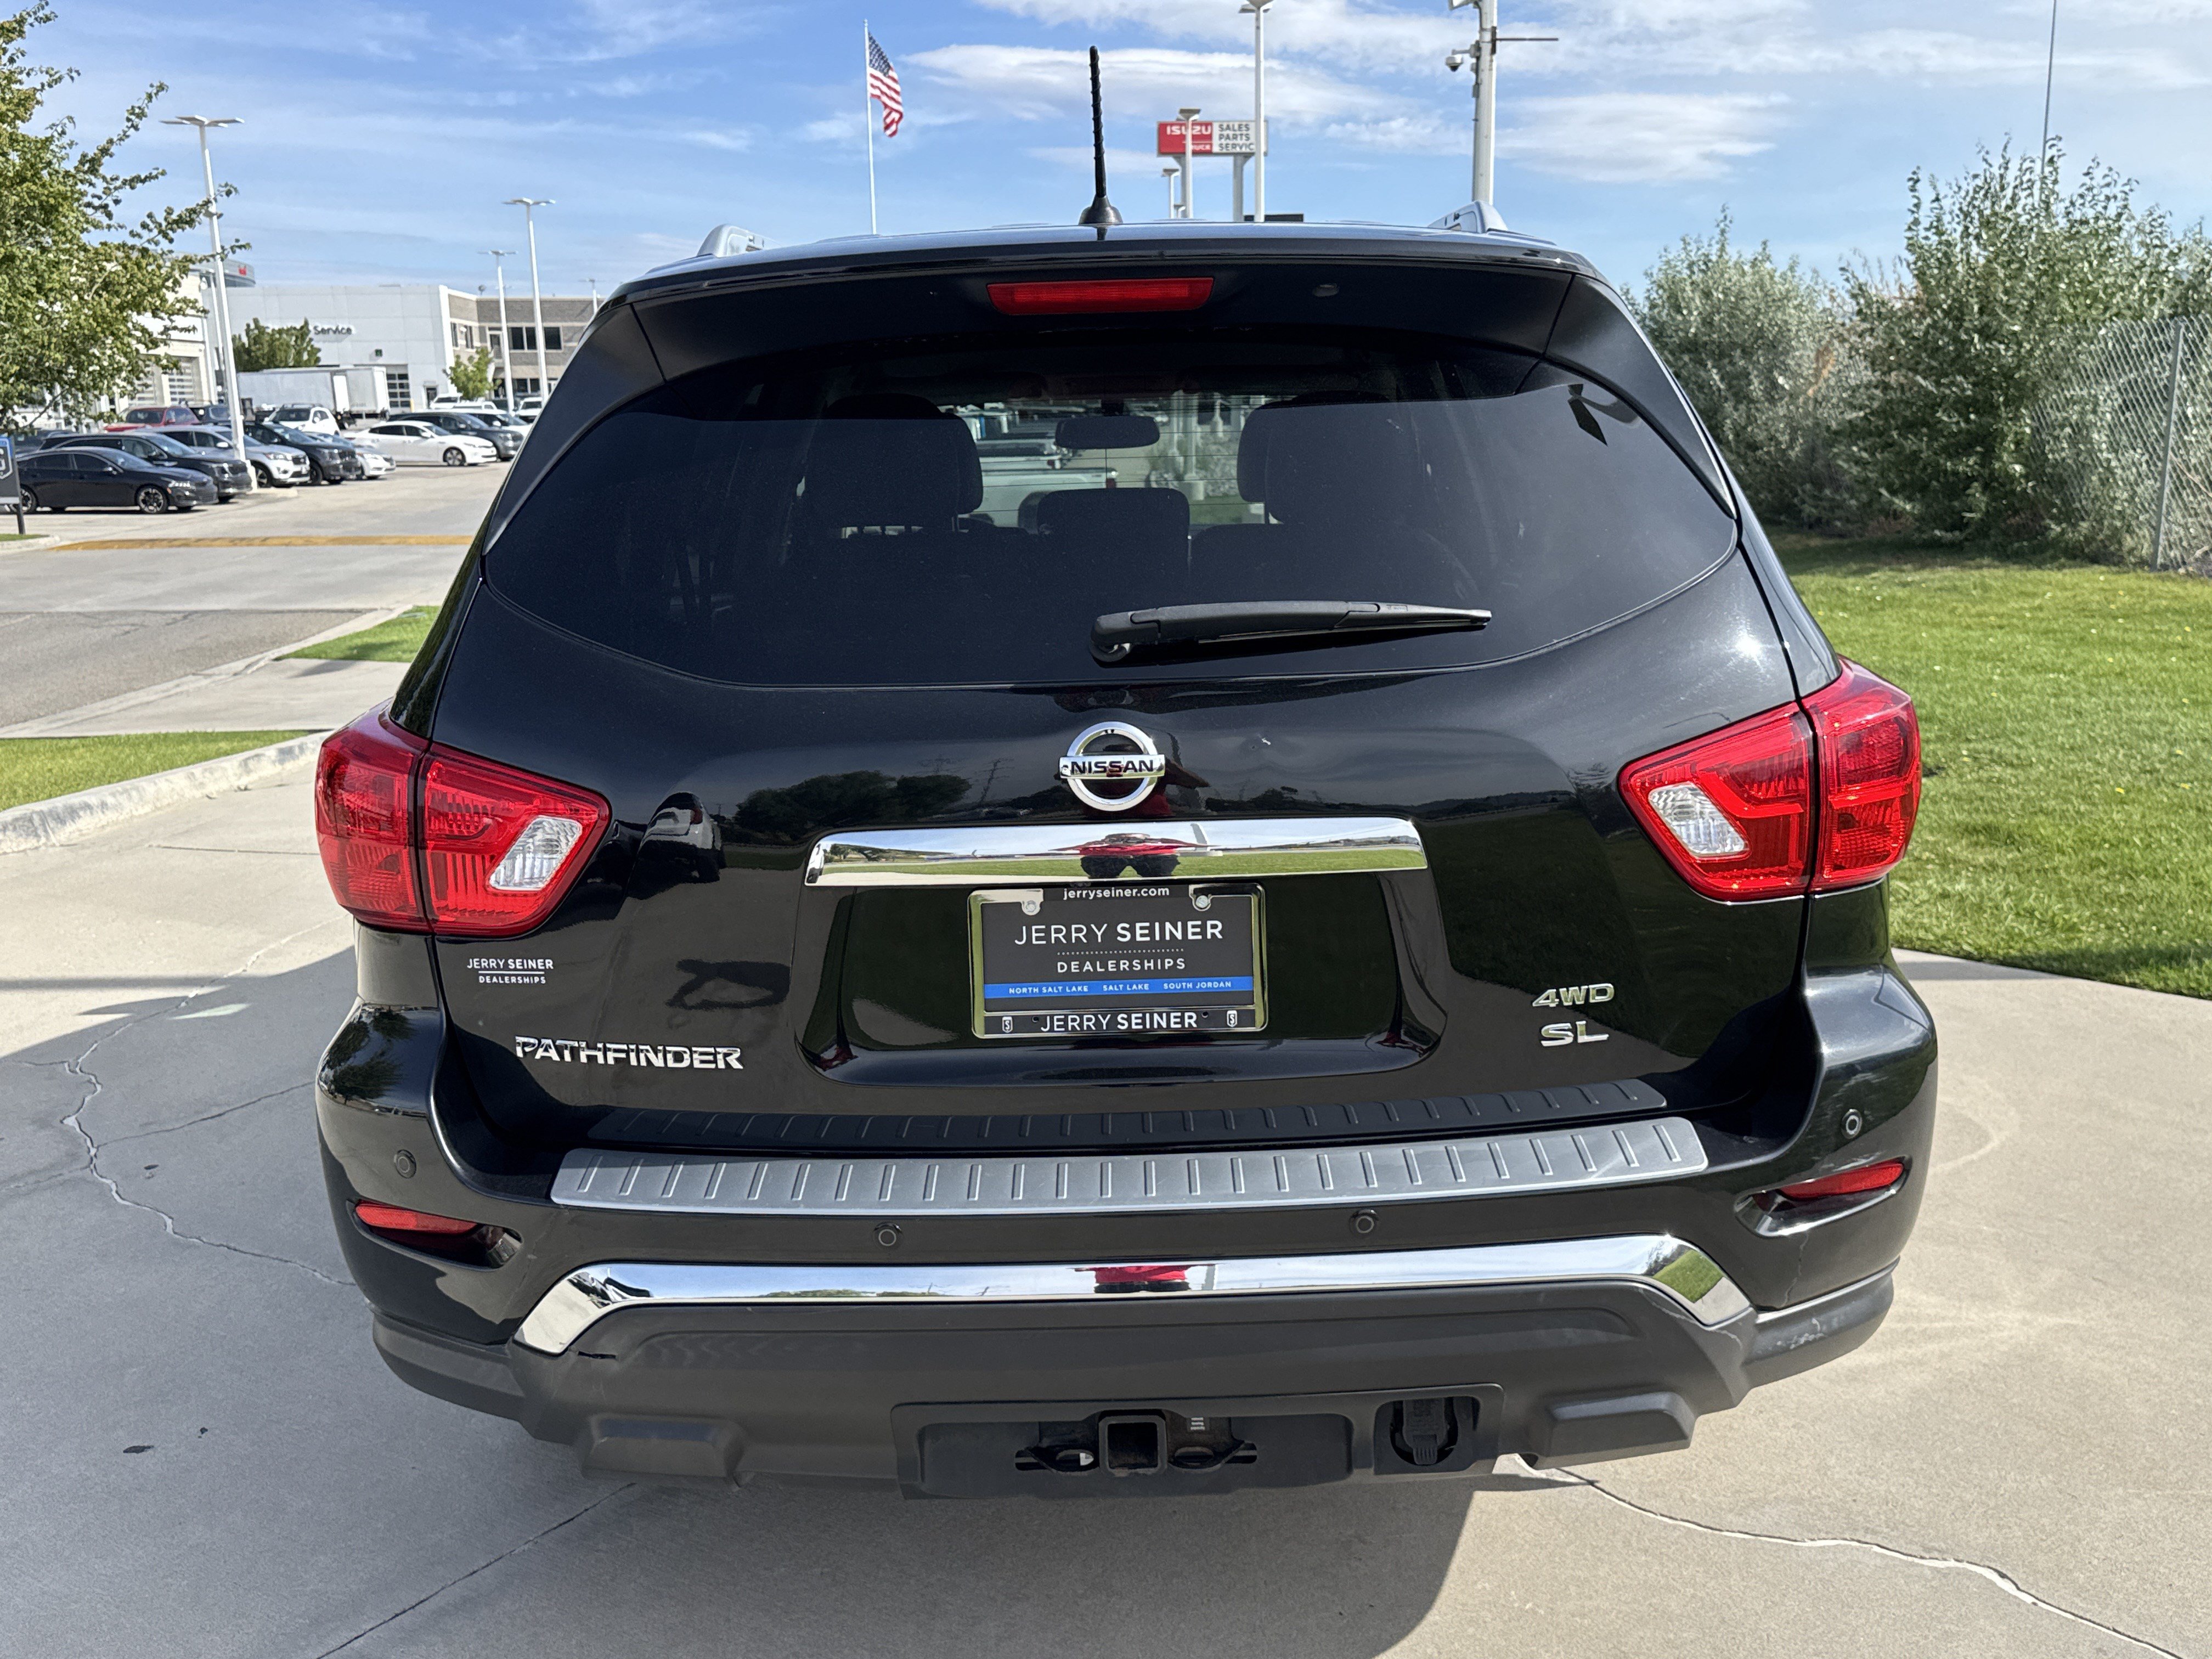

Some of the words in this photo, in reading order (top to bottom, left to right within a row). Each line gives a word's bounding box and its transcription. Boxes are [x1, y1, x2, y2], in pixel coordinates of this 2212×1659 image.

[1218, 123, 1250, 132] SALES
[1218, 133, 1250, 142] PARTS
[313, 325, 352, 335] Service
[1071, 760, 1154, 775] NISSAN
[1063, 887, 1170, 900] jerryseiner.com
[1015, 923, 1108, 945] JERRY
[1116, 920, 1223, 942] SEINER
[467, 958, 505, 969] JERRY
[507, 958, 554, 969] SEINER
[1057, 958, 1186, 973] DEALERSHIPS
[478, 975, 546, 984] DEALERSHIPS
[1532, 983, 1615, 1007] 4WD
[1041, 1014, 1111, 1032] JERRY
[1117, 1012, 1198, 1030] SEINER
[1541, 1020, 1610, 1047] SL
[515, 1035, 744, 1069] PATHFINDER
